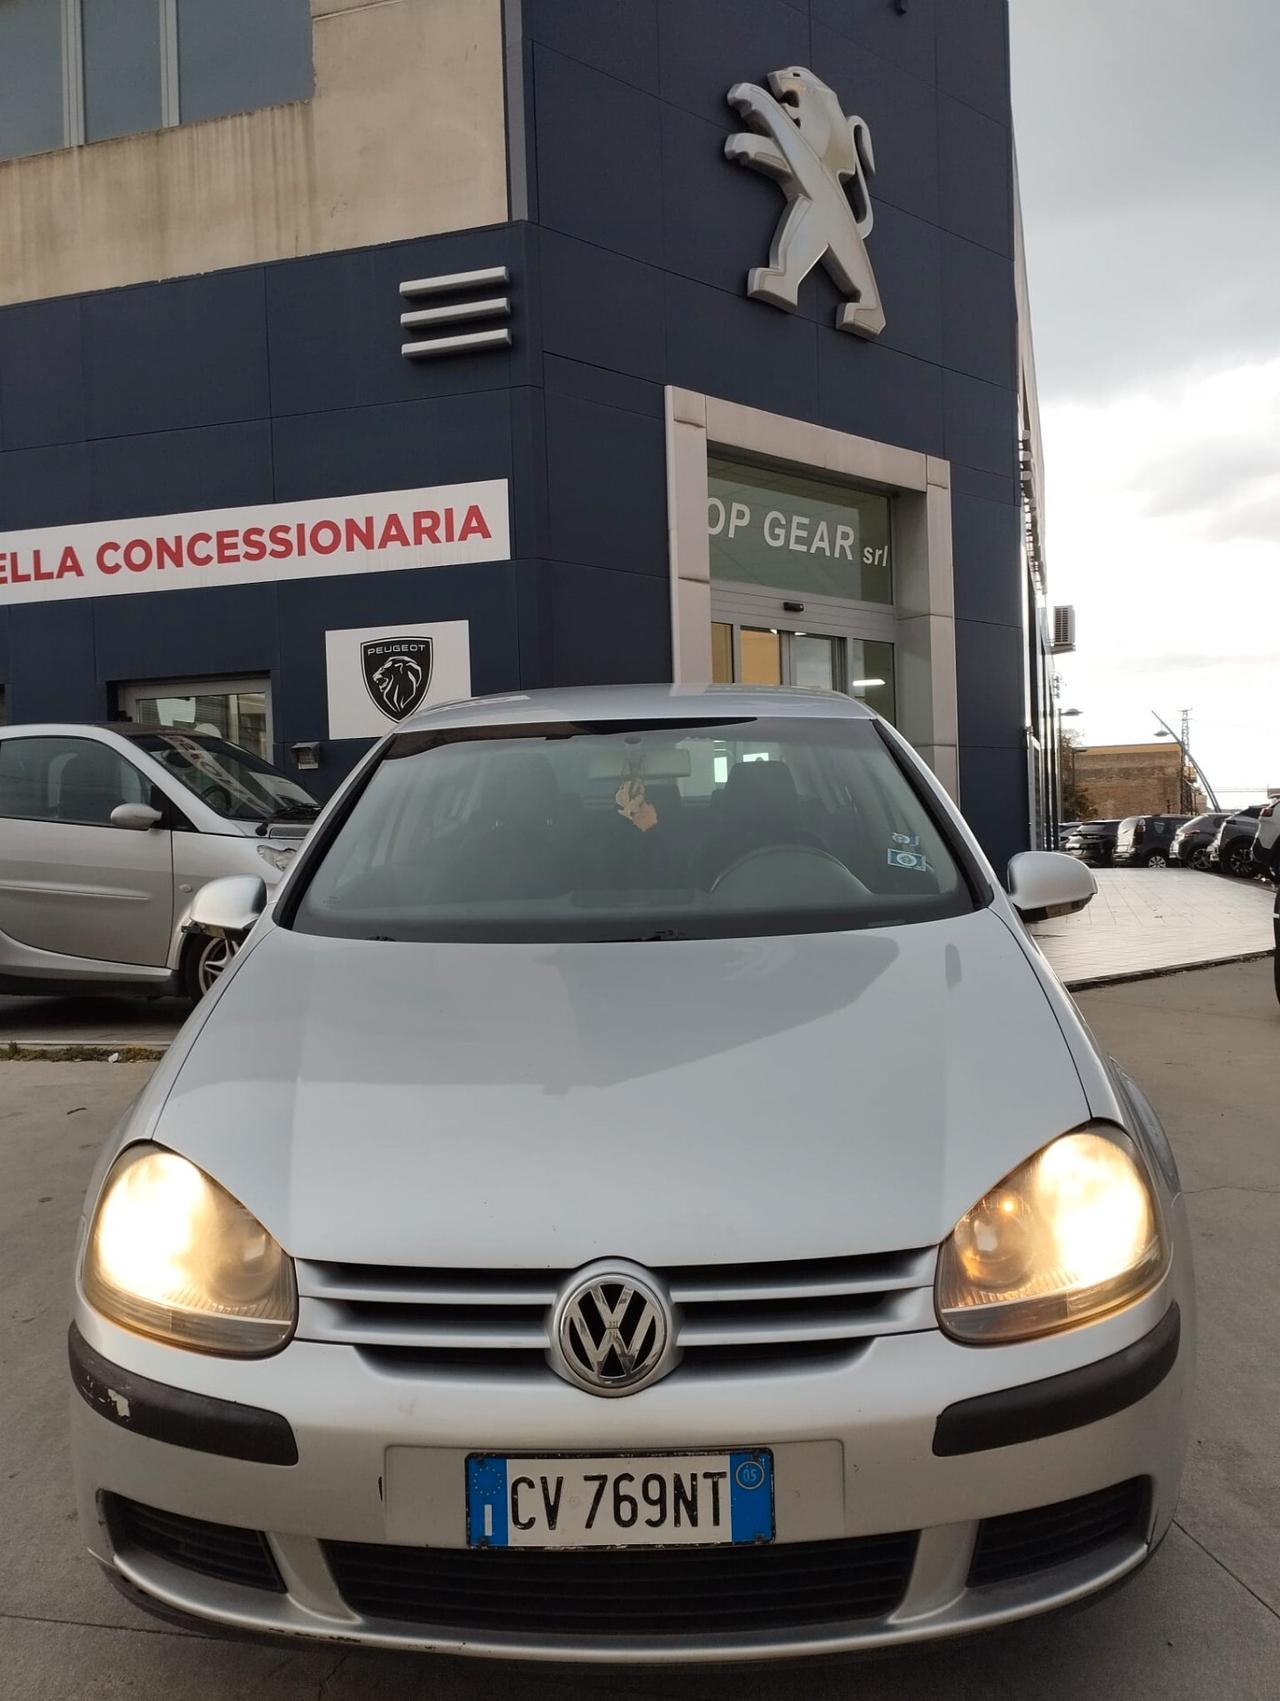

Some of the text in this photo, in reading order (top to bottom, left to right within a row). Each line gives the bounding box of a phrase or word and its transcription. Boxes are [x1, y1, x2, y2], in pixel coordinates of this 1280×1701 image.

[96, 505, 492, 575] CONCESSIONARIA
[764, 511, 855, 561] GEAR
[863, 545, 888, 567] srl
[367, 644, 426, 656] PEUGEOT
[743, 1468, 757, 1482] 05
[484, 1504, 493, 1536] I
[510, 1472, 727, 1530] CV 769NT
